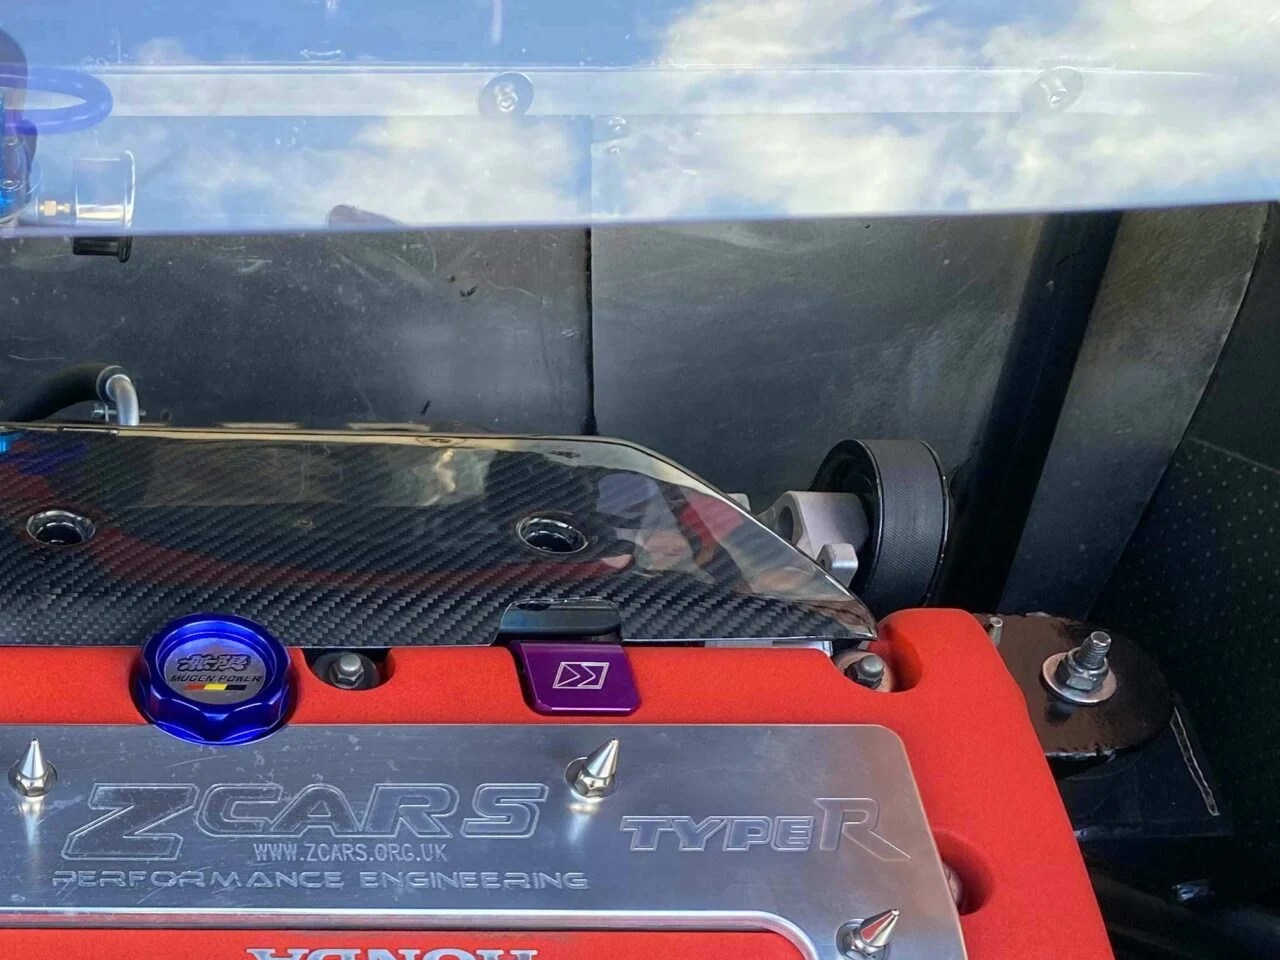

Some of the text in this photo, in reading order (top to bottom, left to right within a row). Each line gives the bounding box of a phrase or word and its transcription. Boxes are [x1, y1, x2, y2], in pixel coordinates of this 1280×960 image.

[170, 674, 263, 683] MUGEN POWER
[253, 842, 448, 863] WWW.ZCARS.ORG.UK
[52, 870, 589, 890] PERFORMANCE ENGINEERING
